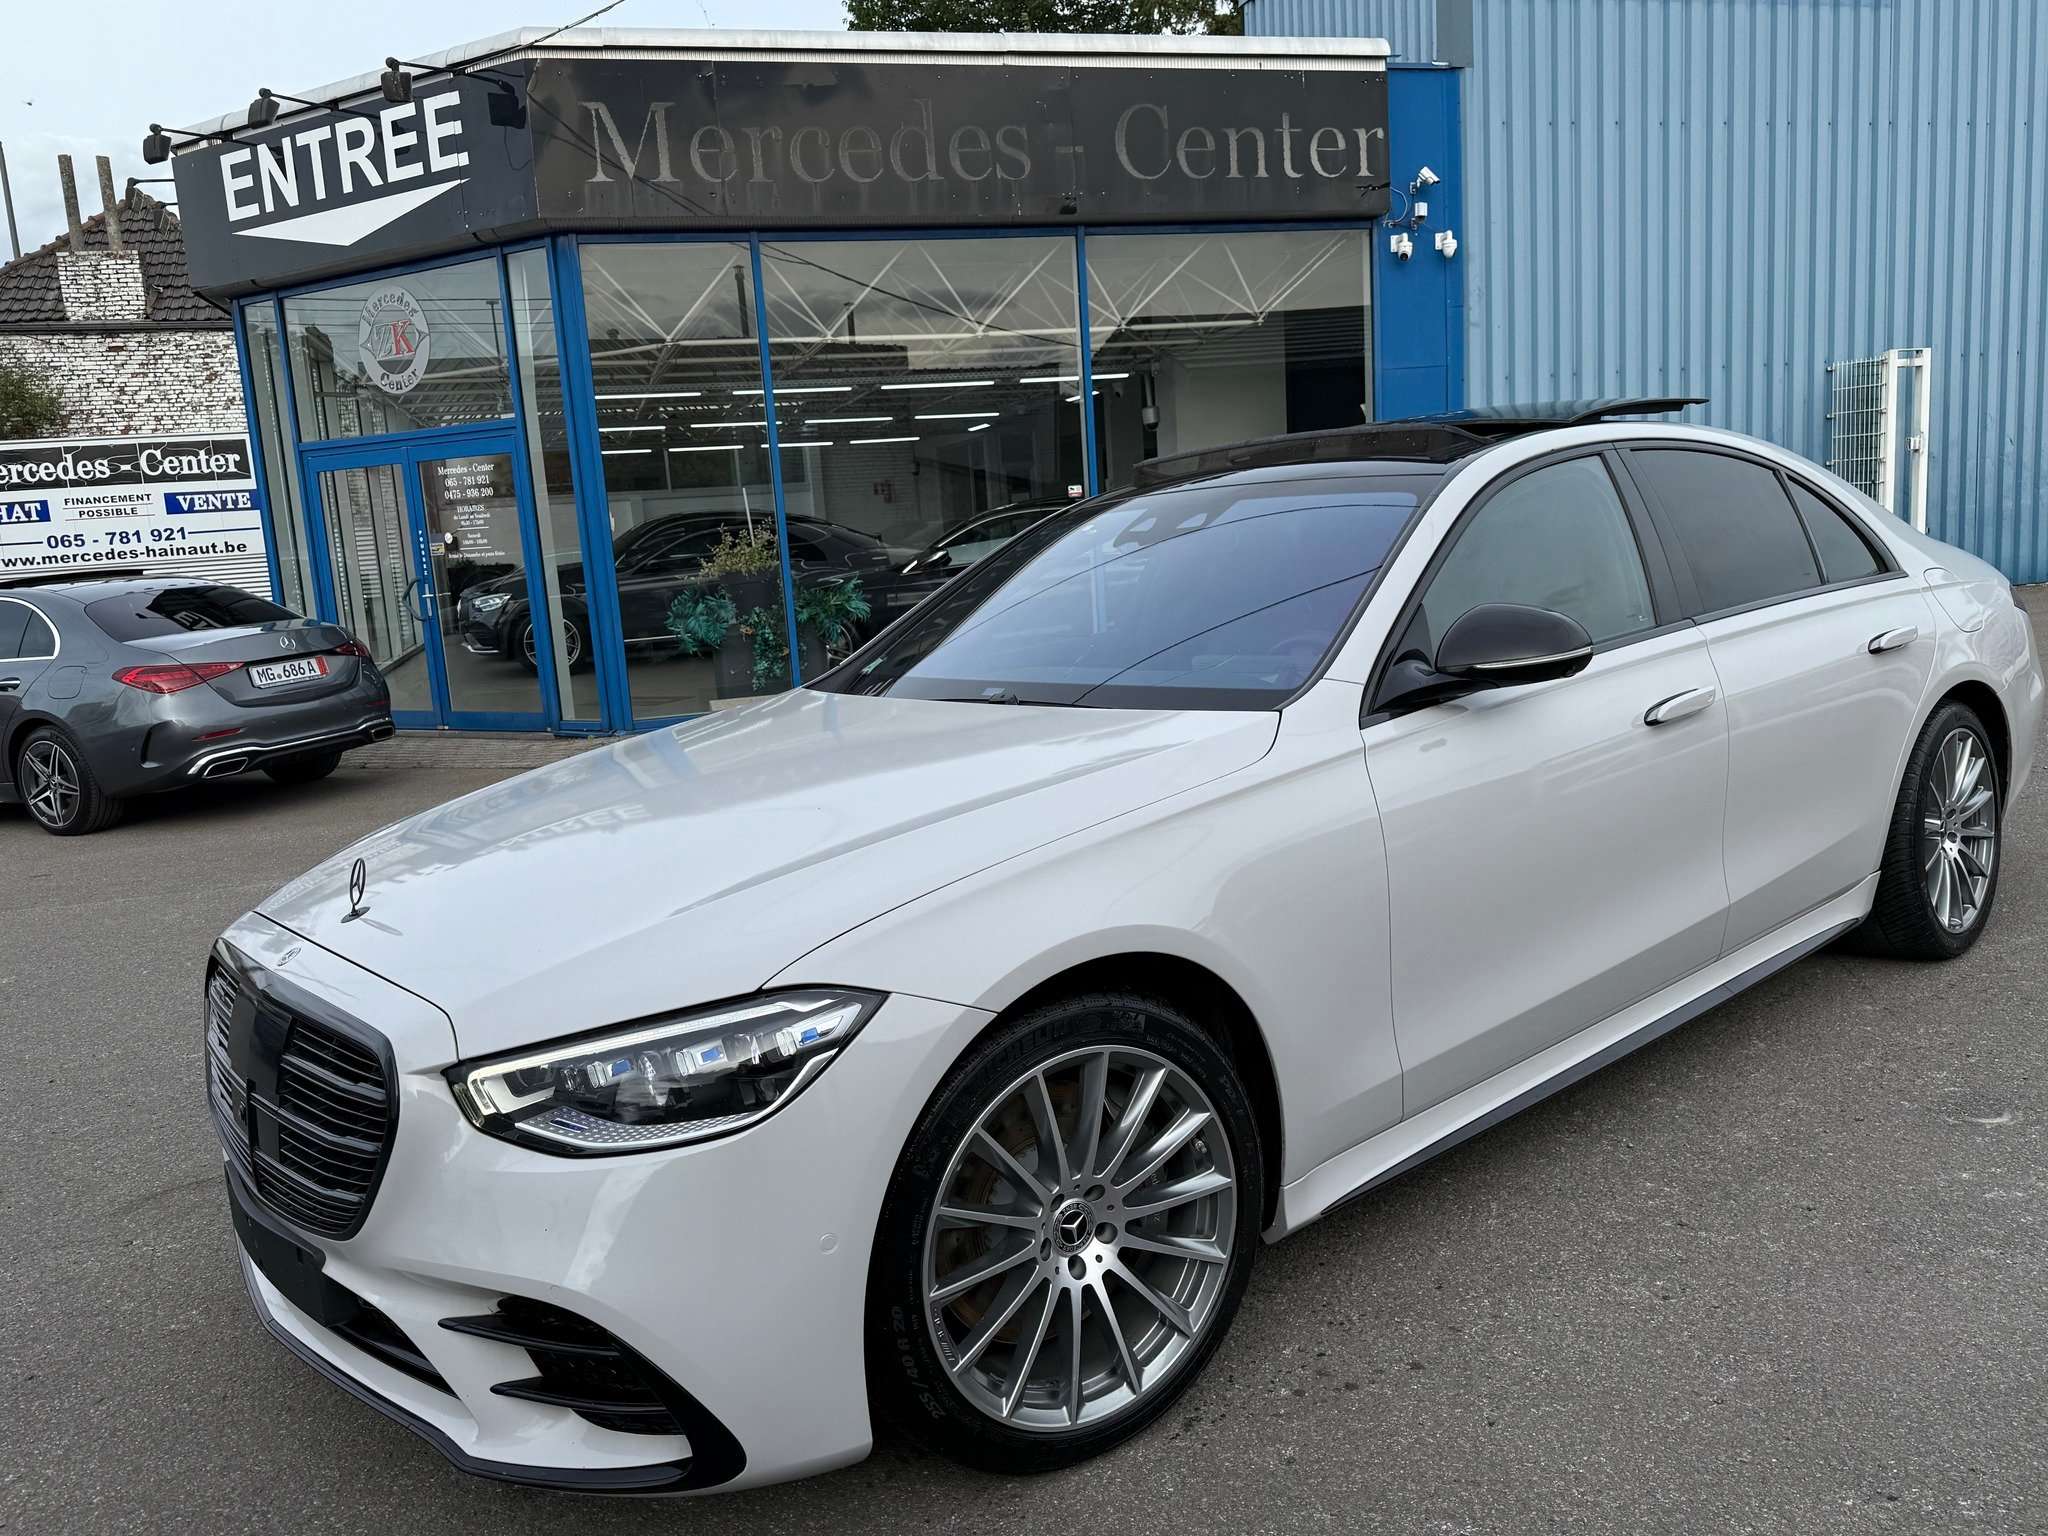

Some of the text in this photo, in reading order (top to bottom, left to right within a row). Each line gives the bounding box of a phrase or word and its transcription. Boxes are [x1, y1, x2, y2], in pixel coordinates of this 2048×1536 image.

[578, 99, 1032, 184] Mercedes
[1114, 103, 1385, 181] Center
[219, 90, 471, 222] ENTREE
[361, 291, 419, 327] Mercedes
[380, 368, 417, 391] Center
[140, 449, 240, 476] Center
[437, 464, 468, 476] Mercedes
[472, 462, 495, 472] Center
[445, 477, 458, 487] 065
[463, 475, 475, 486] 781
[476, 474, 489, 485] 921
[64, 493, 152, 506] FINANCEMENT
[176, 492, 251, 511] VENTE
[480, 487, 494, 497] 200
[79, 506, 138, 518] POSSIBLE
[46, 534, 85, 549] 065
[105, 529, 142, 546] 781
[150, 526, 186, 542] 921
